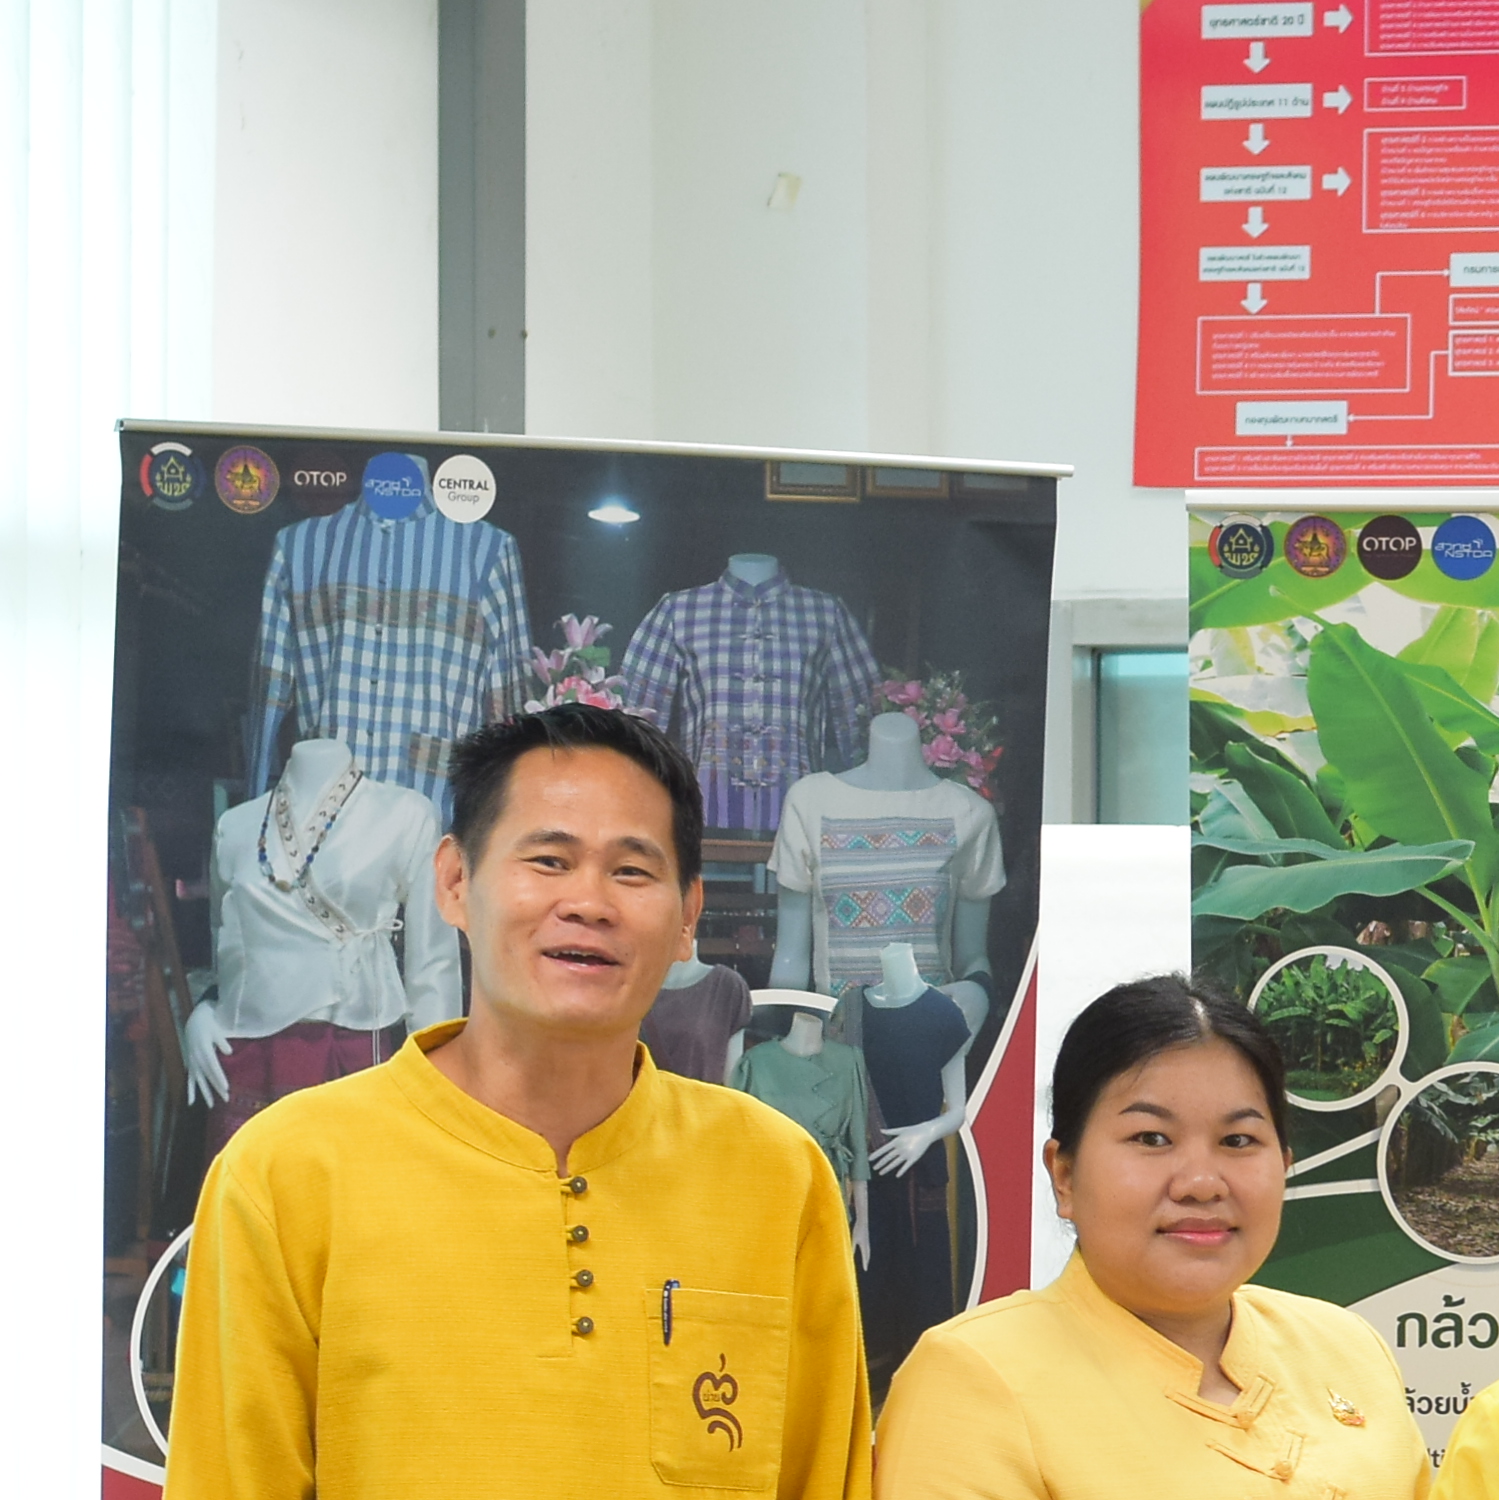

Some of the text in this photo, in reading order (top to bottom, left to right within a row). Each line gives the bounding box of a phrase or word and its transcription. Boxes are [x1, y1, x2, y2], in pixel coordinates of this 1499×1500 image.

[1282, 16, 1294, 26] 20
[1278, 98, 1289, 107] 11
[294, 469, 347, 488] OTOP
[438, 476, 490, 492] CENTRAL
[447, 490, 481, 505] Group
[1362, 536, 1417, 552] OTOP
